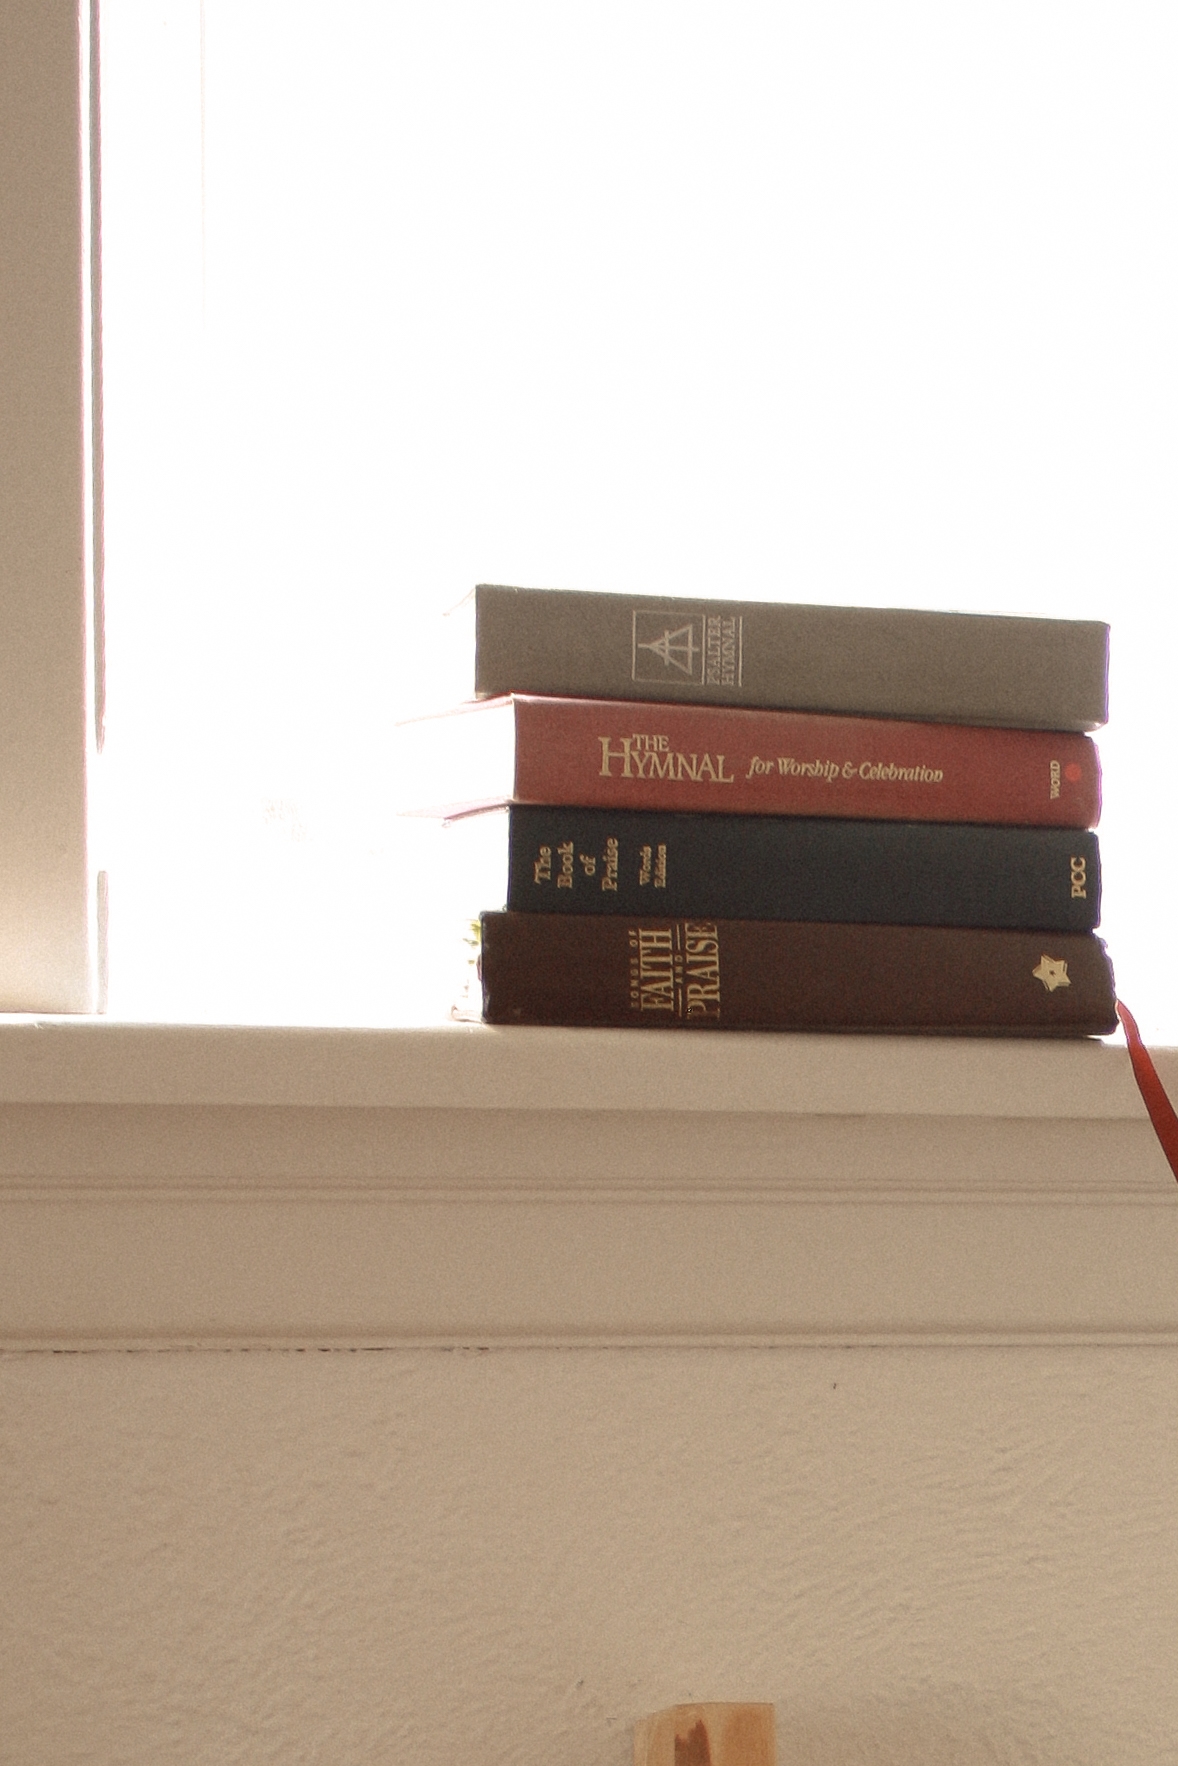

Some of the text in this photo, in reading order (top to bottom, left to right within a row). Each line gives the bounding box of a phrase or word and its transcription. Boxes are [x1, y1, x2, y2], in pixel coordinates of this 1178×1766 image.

[706, 615, 721, 686] PSALTER
[598, 736, 944, 783] HYMNAL for Worship & Celebration
[632, 733, 670, 752] THE
[1050, 760, 1061, 800] WORD
[534, 845, 552, 885] The
[557, 840, 574, 889] Book
[579, 853, 596, 876] of
[602, 836, 619, 892] Praise
[1070, 856, 1086, 899] PCC
[638, 928, 674, 1012] FAITH
[674, 954, 683, 984] AND
[684, 922, 720, 1019] PRAISE
